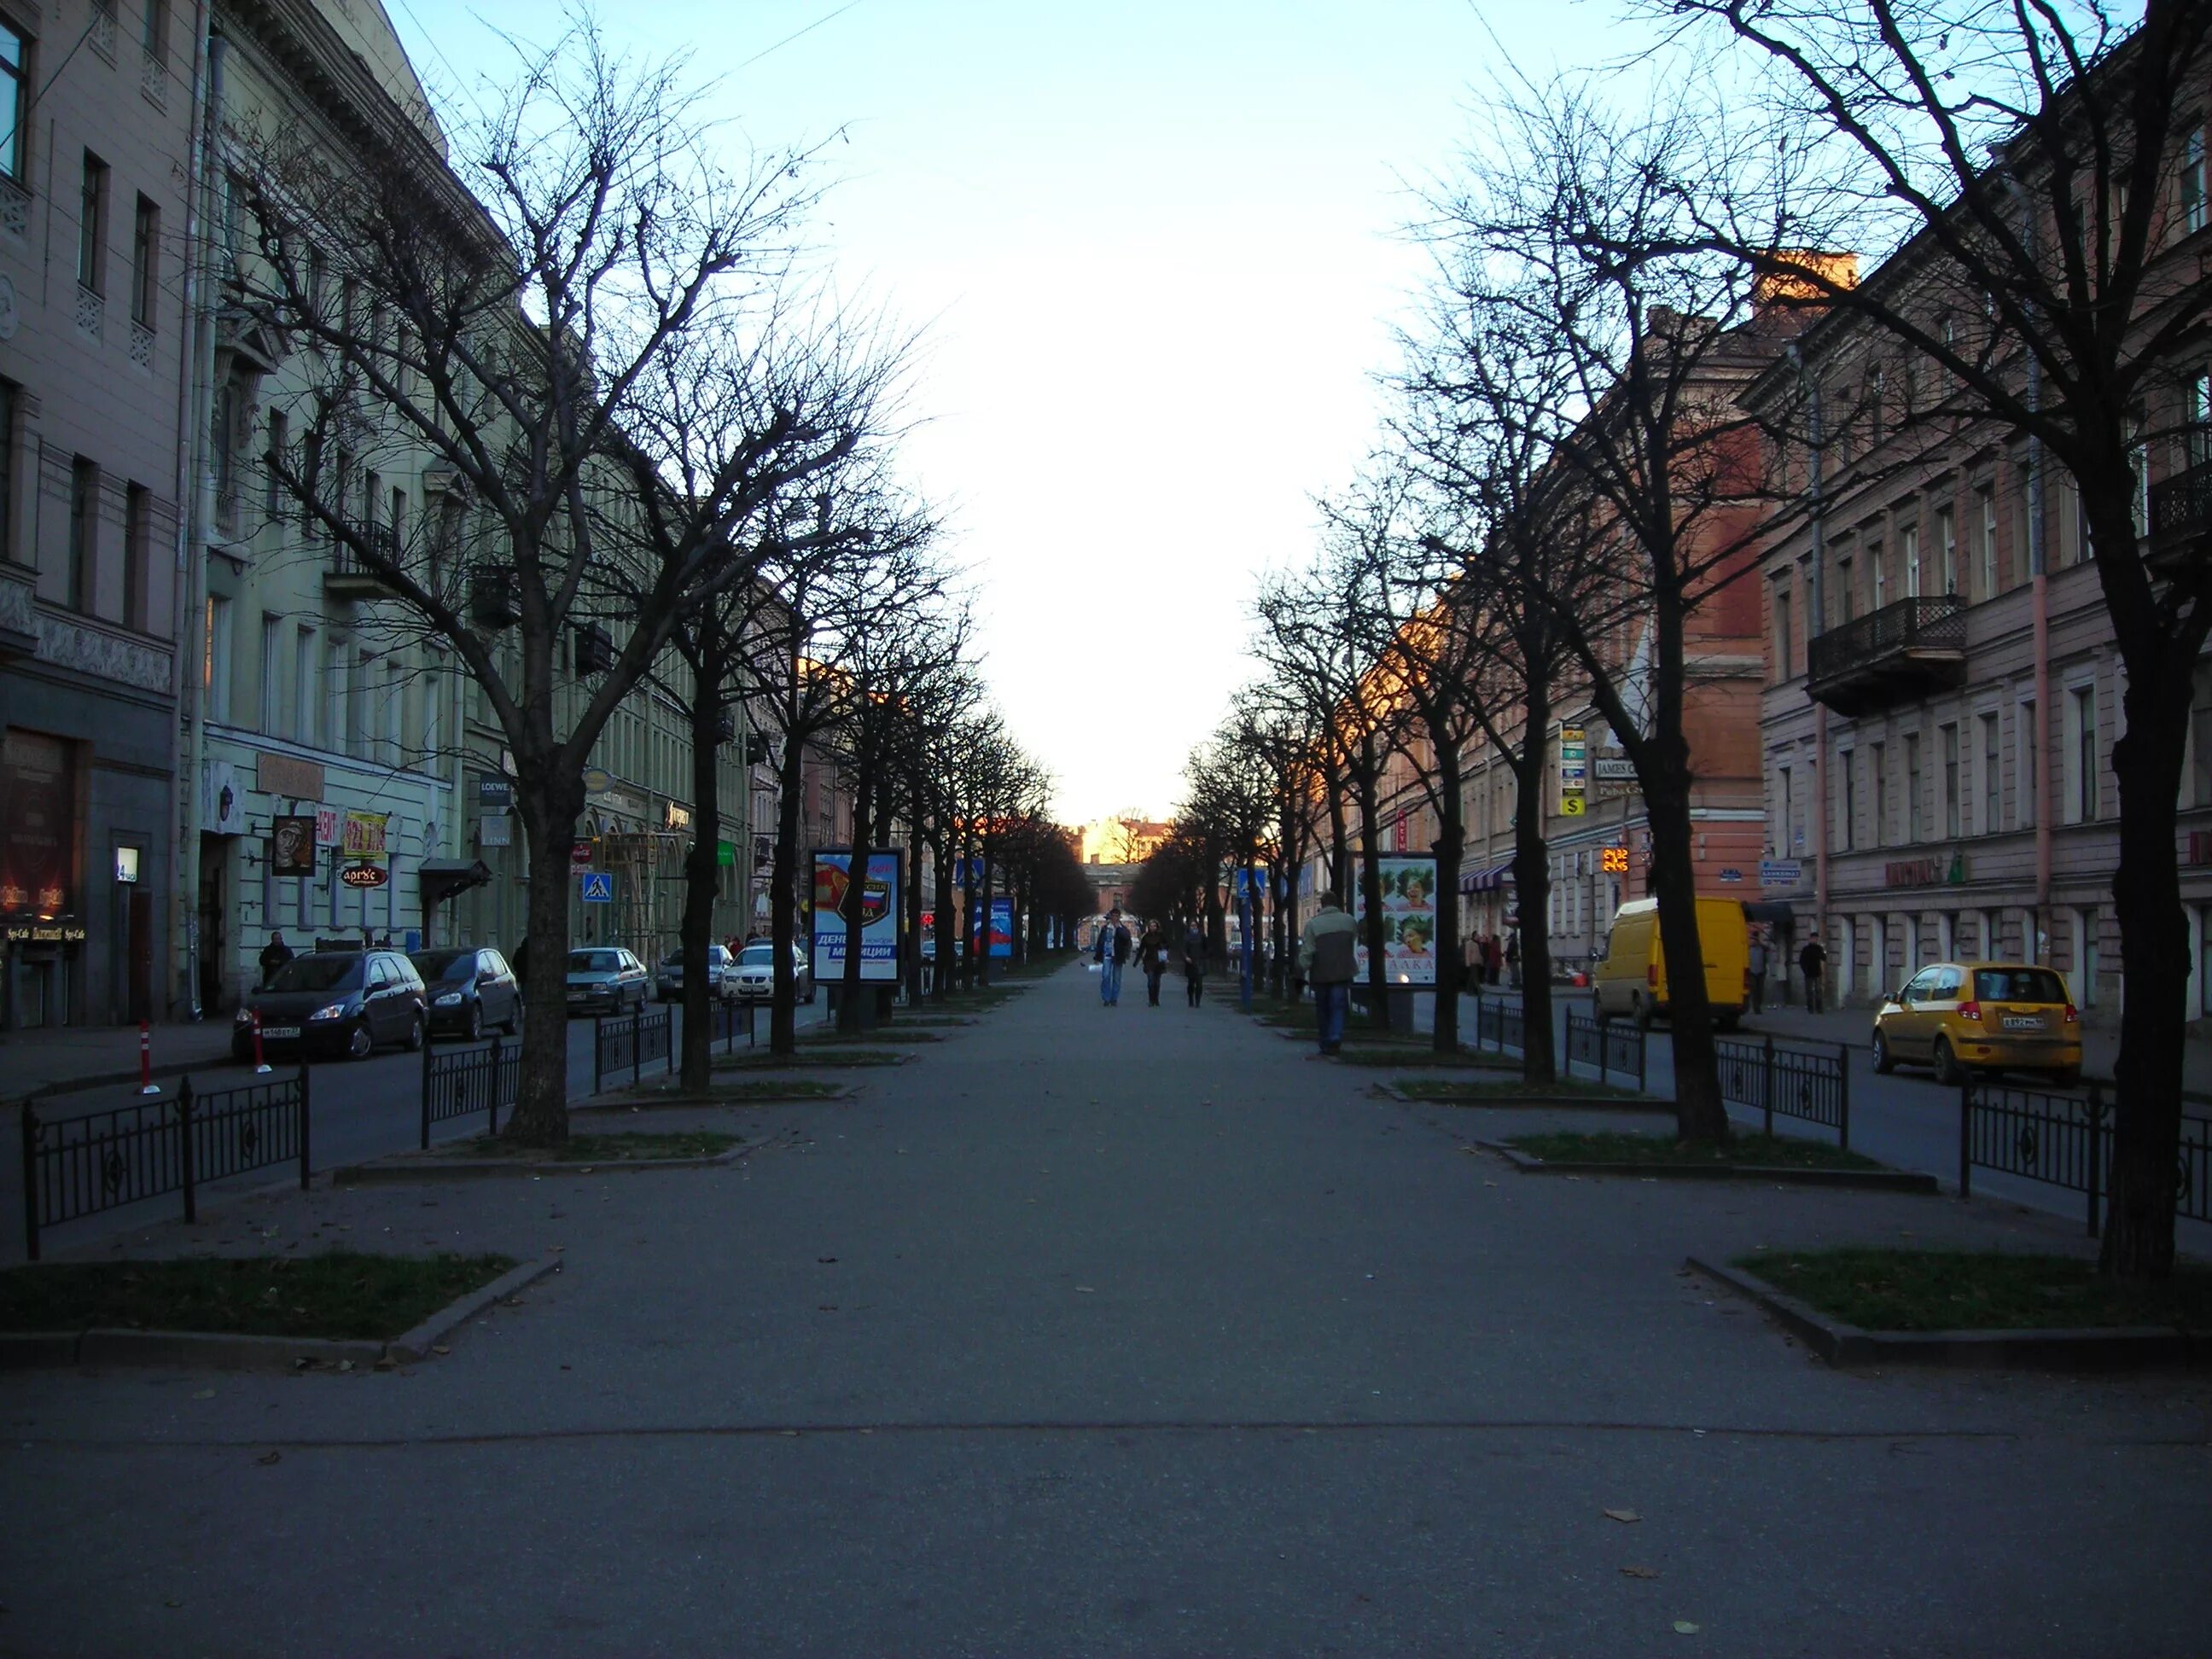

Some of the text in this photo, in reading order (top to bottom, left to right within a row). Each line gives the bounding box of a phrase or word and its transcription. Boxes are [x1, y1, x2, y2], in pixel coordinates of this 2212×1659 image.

[1598, 763, 1626, 774] JAMES
[1568, 800, 1578, 812] $
[831, 946, 892, 958] МИЦИИ
